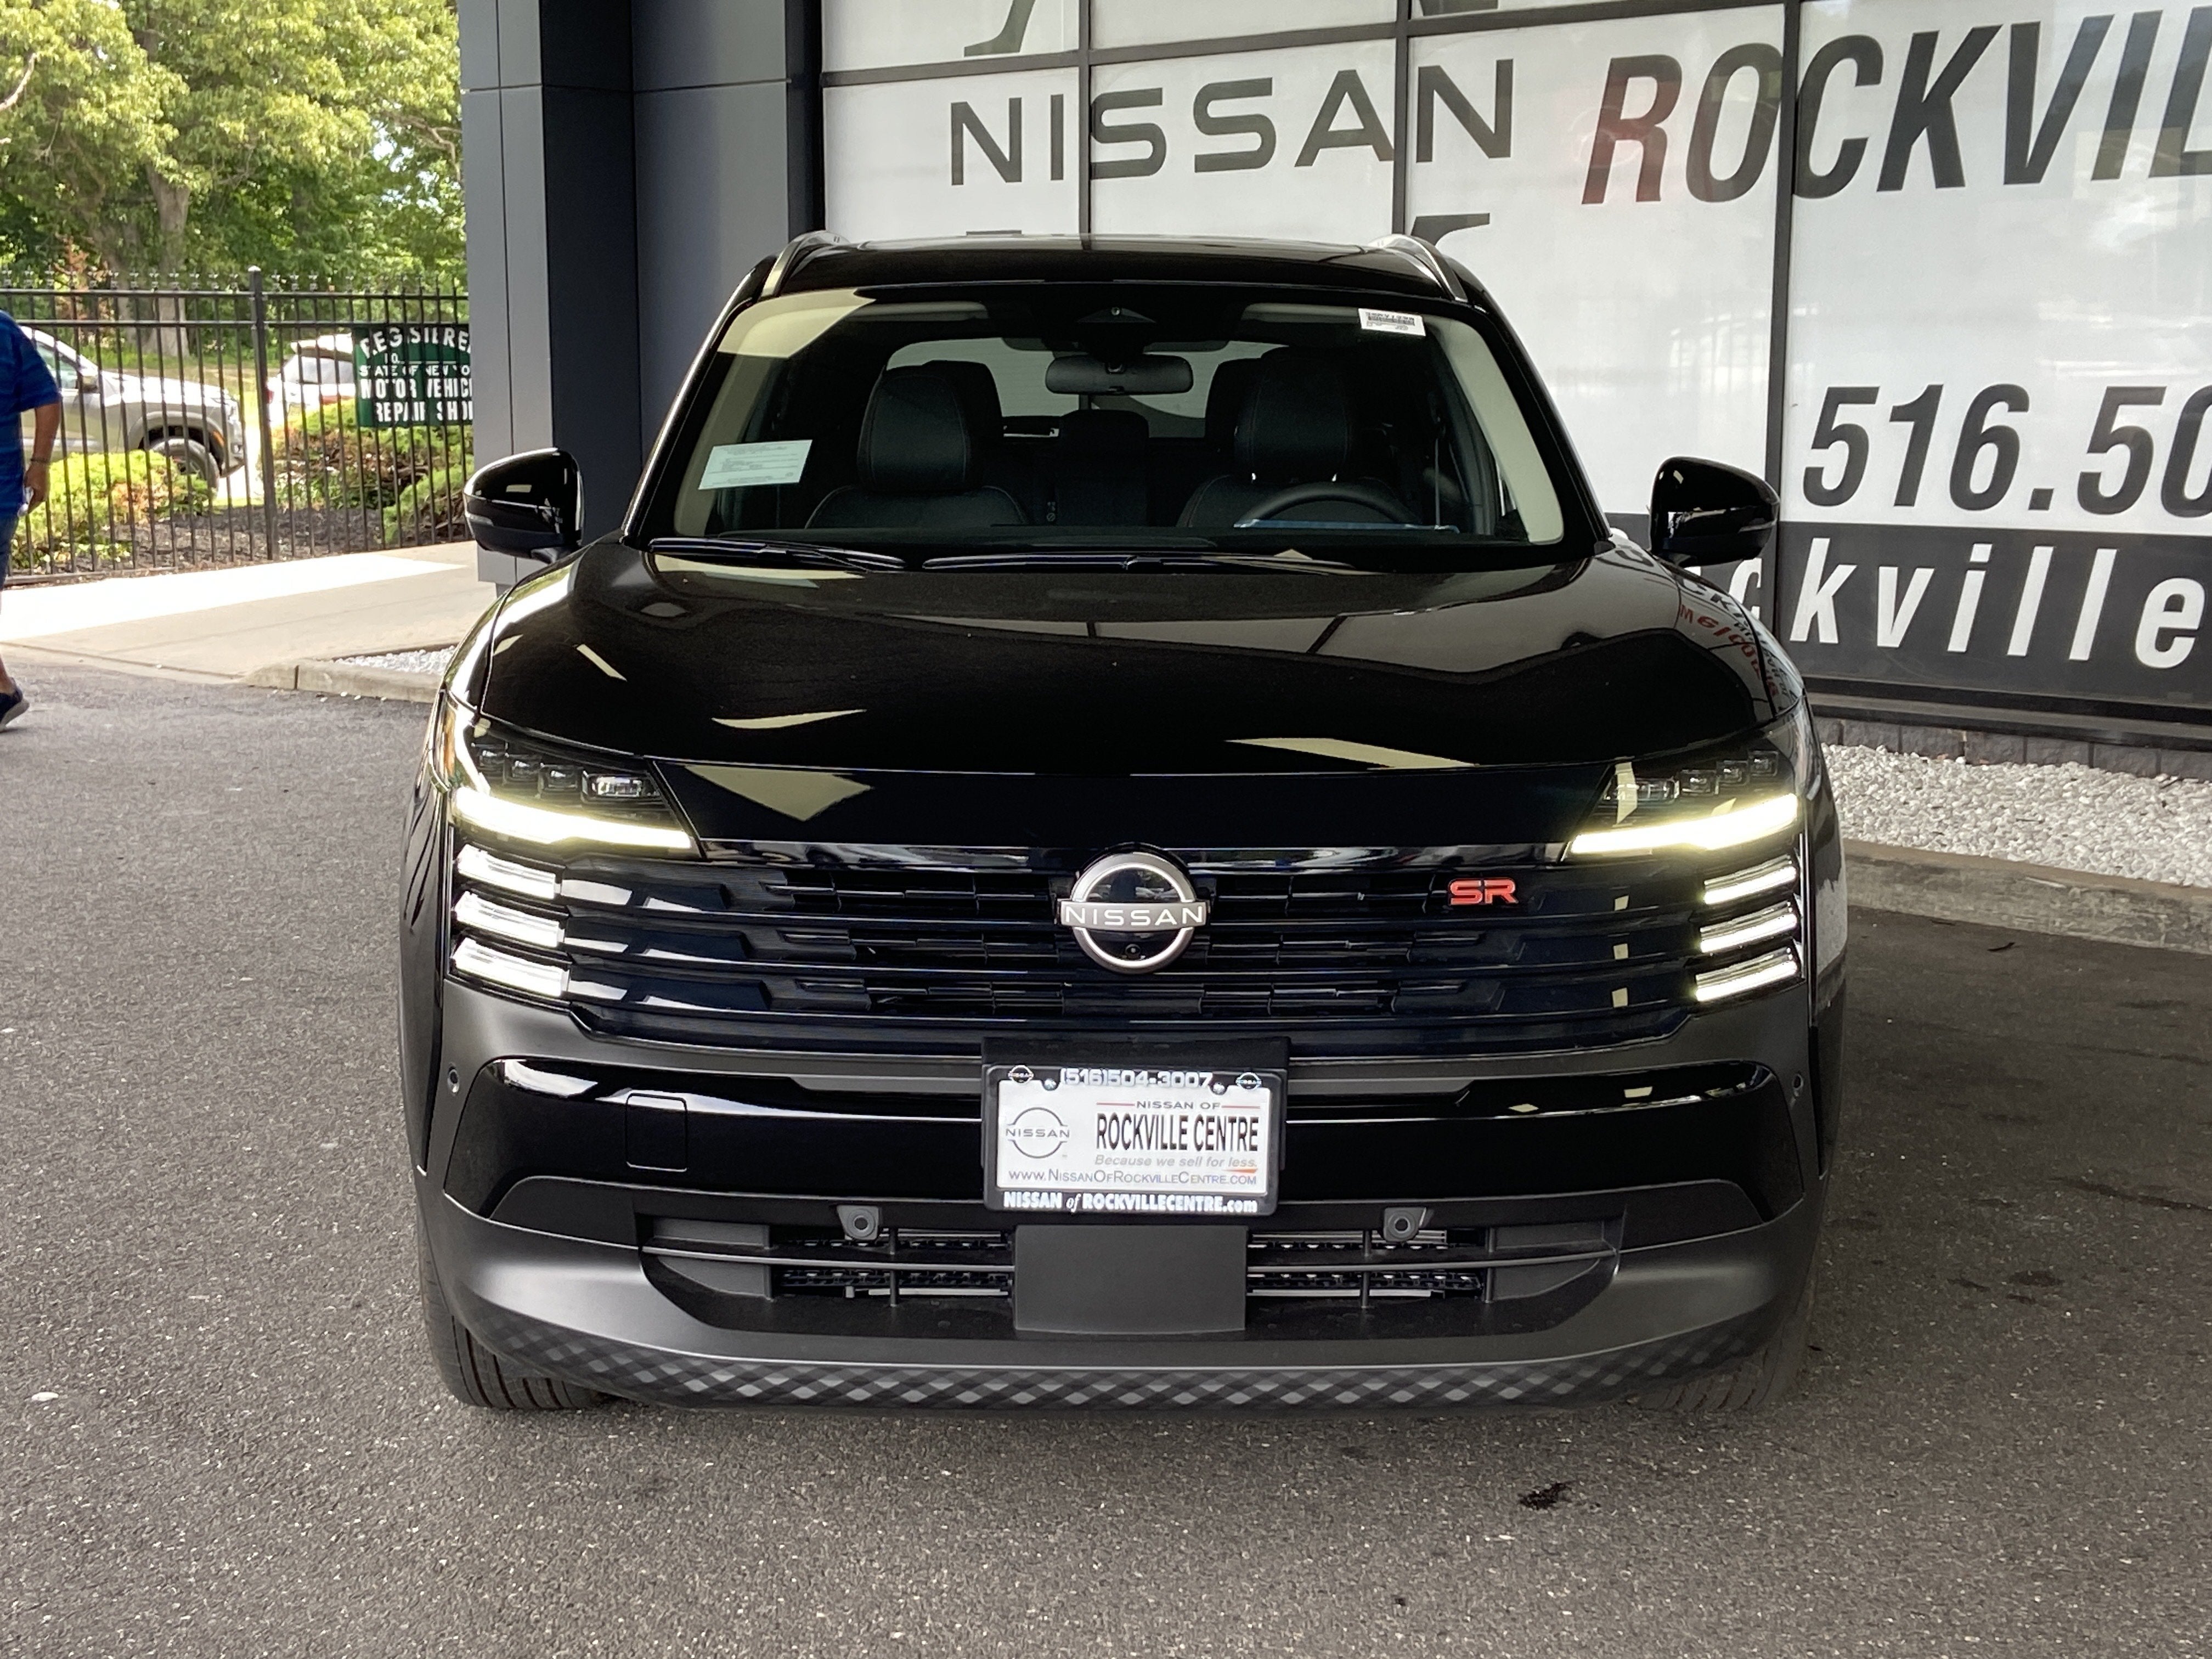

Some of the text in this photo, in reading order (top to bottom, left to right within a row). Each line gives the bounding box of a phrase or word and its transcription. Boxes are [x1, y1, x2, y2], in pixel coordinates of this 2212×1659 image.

[950, 59, 1513, 185] NISSAN
[1449, 878, 1519, 905] SR
[1065, 905, 1204, 926] NISSAN
[1060, 1068, 1213, 1088] (516)504-3007
[1136, 1101, 1221, 1110] NISSAN OF
[1005, 1128, 1070, 1138] NISSAN
[1096, 1112, 1259, 1152] ROCKVILLE CENTRE
[1094, 1154, 1152, 1166] Because
[1156, 1157, 1175, 1166] we
[1179, 1156, 1203, 1167] sell
[1207, 1156, 1224, 1167] for
[1003, 1191, 1258, 1213] NISSAN of ROCKVILLECENTRE.com
